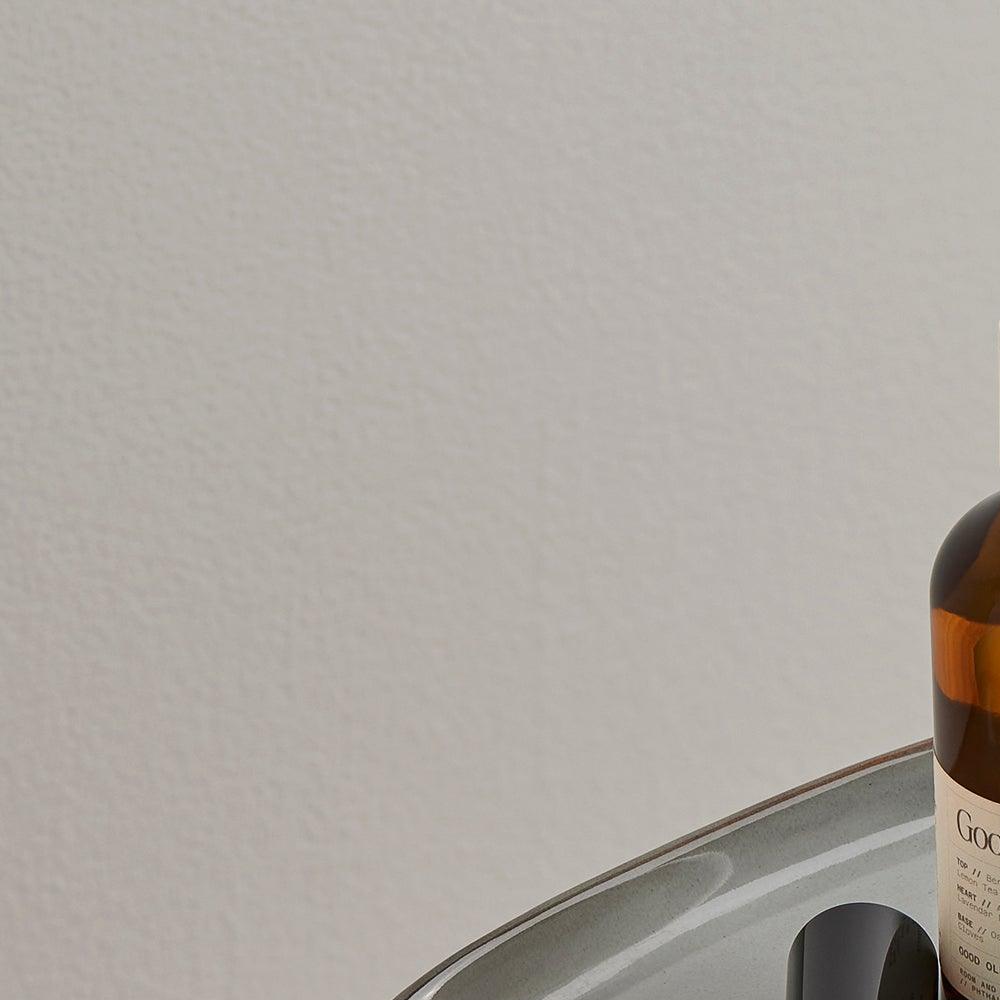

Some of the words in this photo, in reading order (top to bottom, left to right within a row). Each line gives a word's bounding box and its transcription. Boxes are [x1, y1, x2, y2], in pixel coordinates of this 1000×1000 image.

[956, 857, 968, 870] TOP
[957, 884, 977, 901] HEART
[957, 913, 973, 929] BASE
[959, 946, 980, 966] GOOD
[959, 968, 976, 983] ROOM
[981, 981, 996, 993] AND
